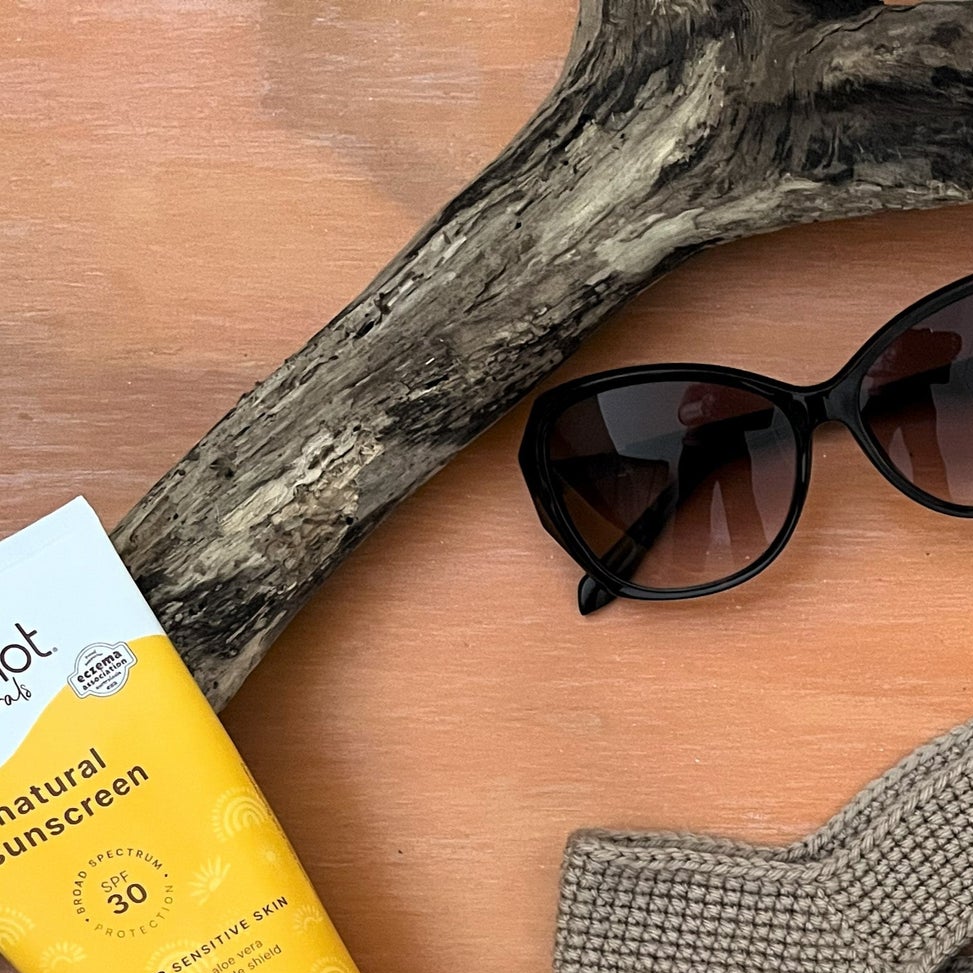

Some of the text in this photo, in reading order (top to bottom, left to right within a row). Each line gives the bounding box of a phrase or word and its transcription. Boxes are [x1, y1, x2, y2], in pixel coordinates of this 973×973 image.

[76, 650, 123, 683] eczema
[82, 658, 128, 691] association
[0, 747, 107, 826] natural
[72, 847, 163, 915] BROAD SPECTRUM
[100, 870, 129, 893] SPF
[93, 884, 174, 939] PROTECTION
[107, 883, 148, 915] 30
[171, 919, 250, 973] SENSITIVE
[252, 896, 289, 921] SKIN
[237, 940, 263, 959] vera
[247, 944, 282, 971] shield
